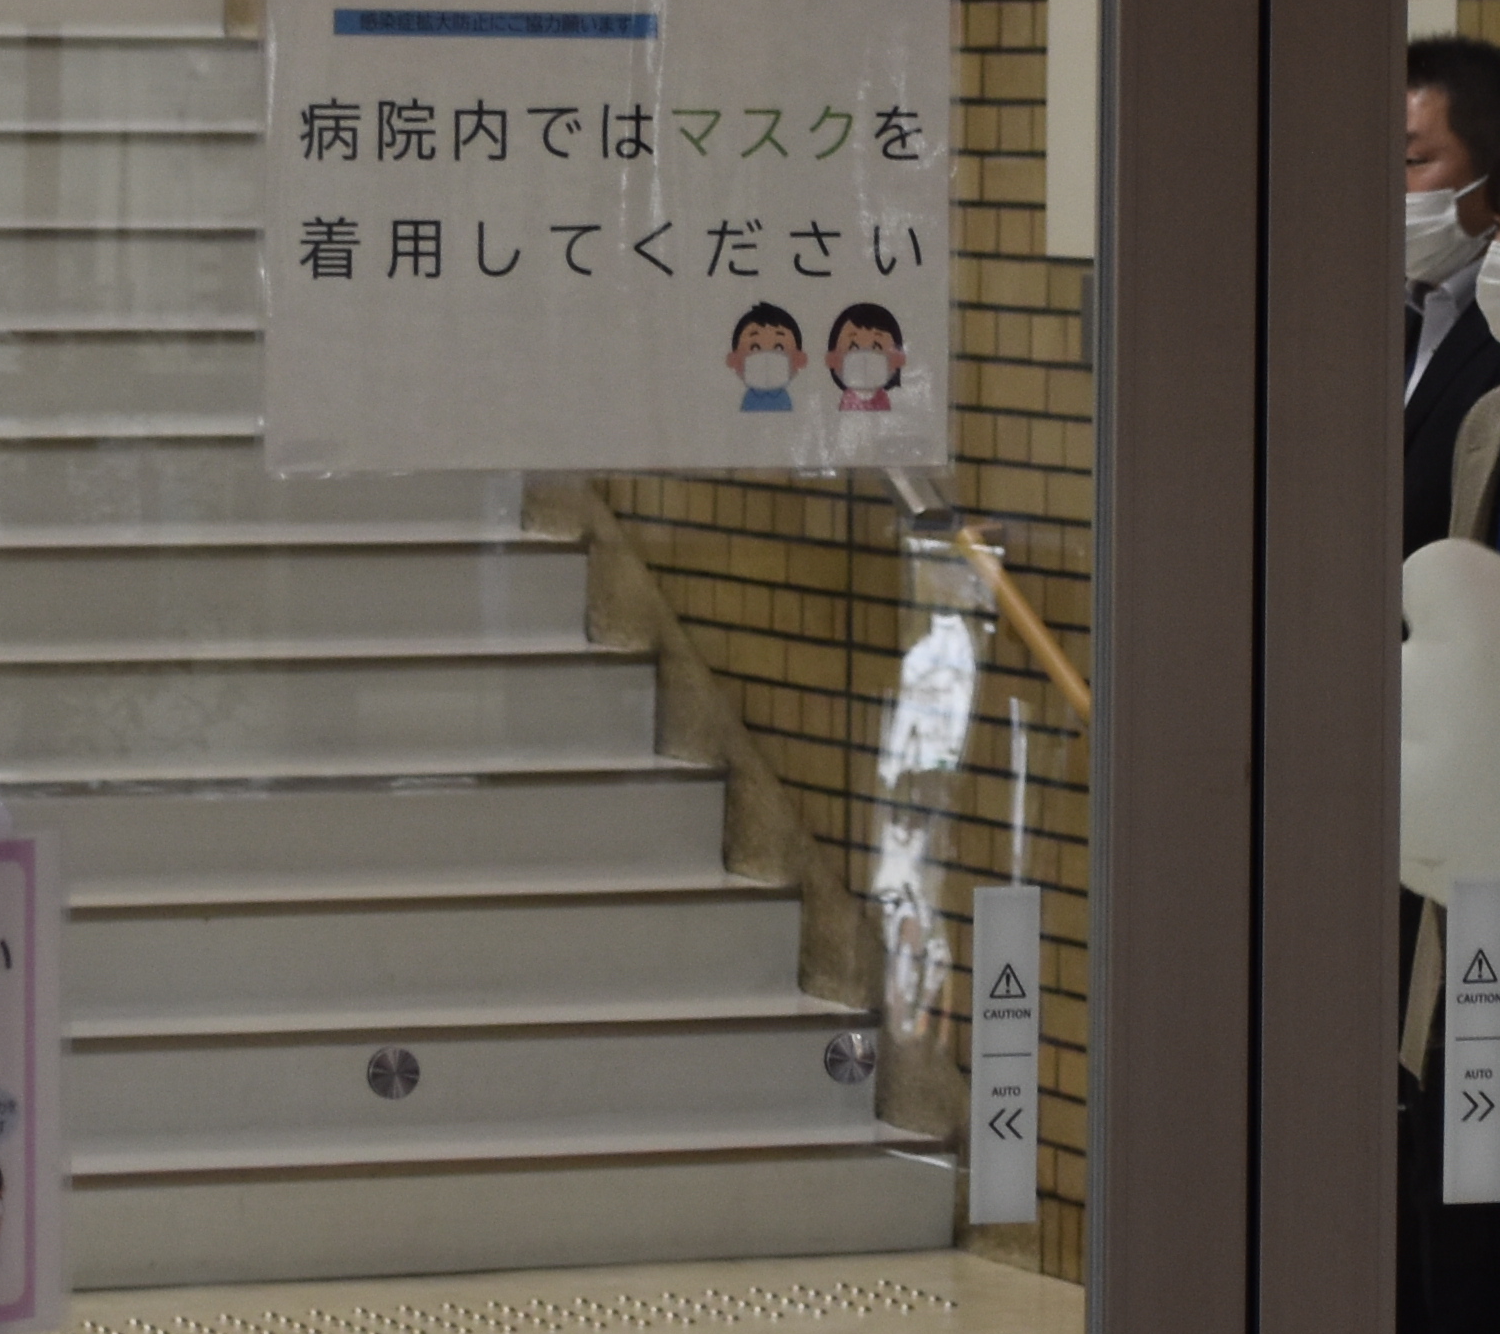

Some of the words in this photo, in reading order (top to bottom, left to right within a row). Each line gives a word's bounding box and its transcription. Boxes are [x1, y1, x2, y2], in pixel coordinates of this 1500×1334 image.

[299, 97, 924, 162] 病院内ではマスクを
[299, 216, 924, 279] 着用してください
[983, 1008, 1032, 1021] CAUTION
[1464, 1068, 1493, 1081] AUTO
[991, 1085, 1022, 1098] AUTO
